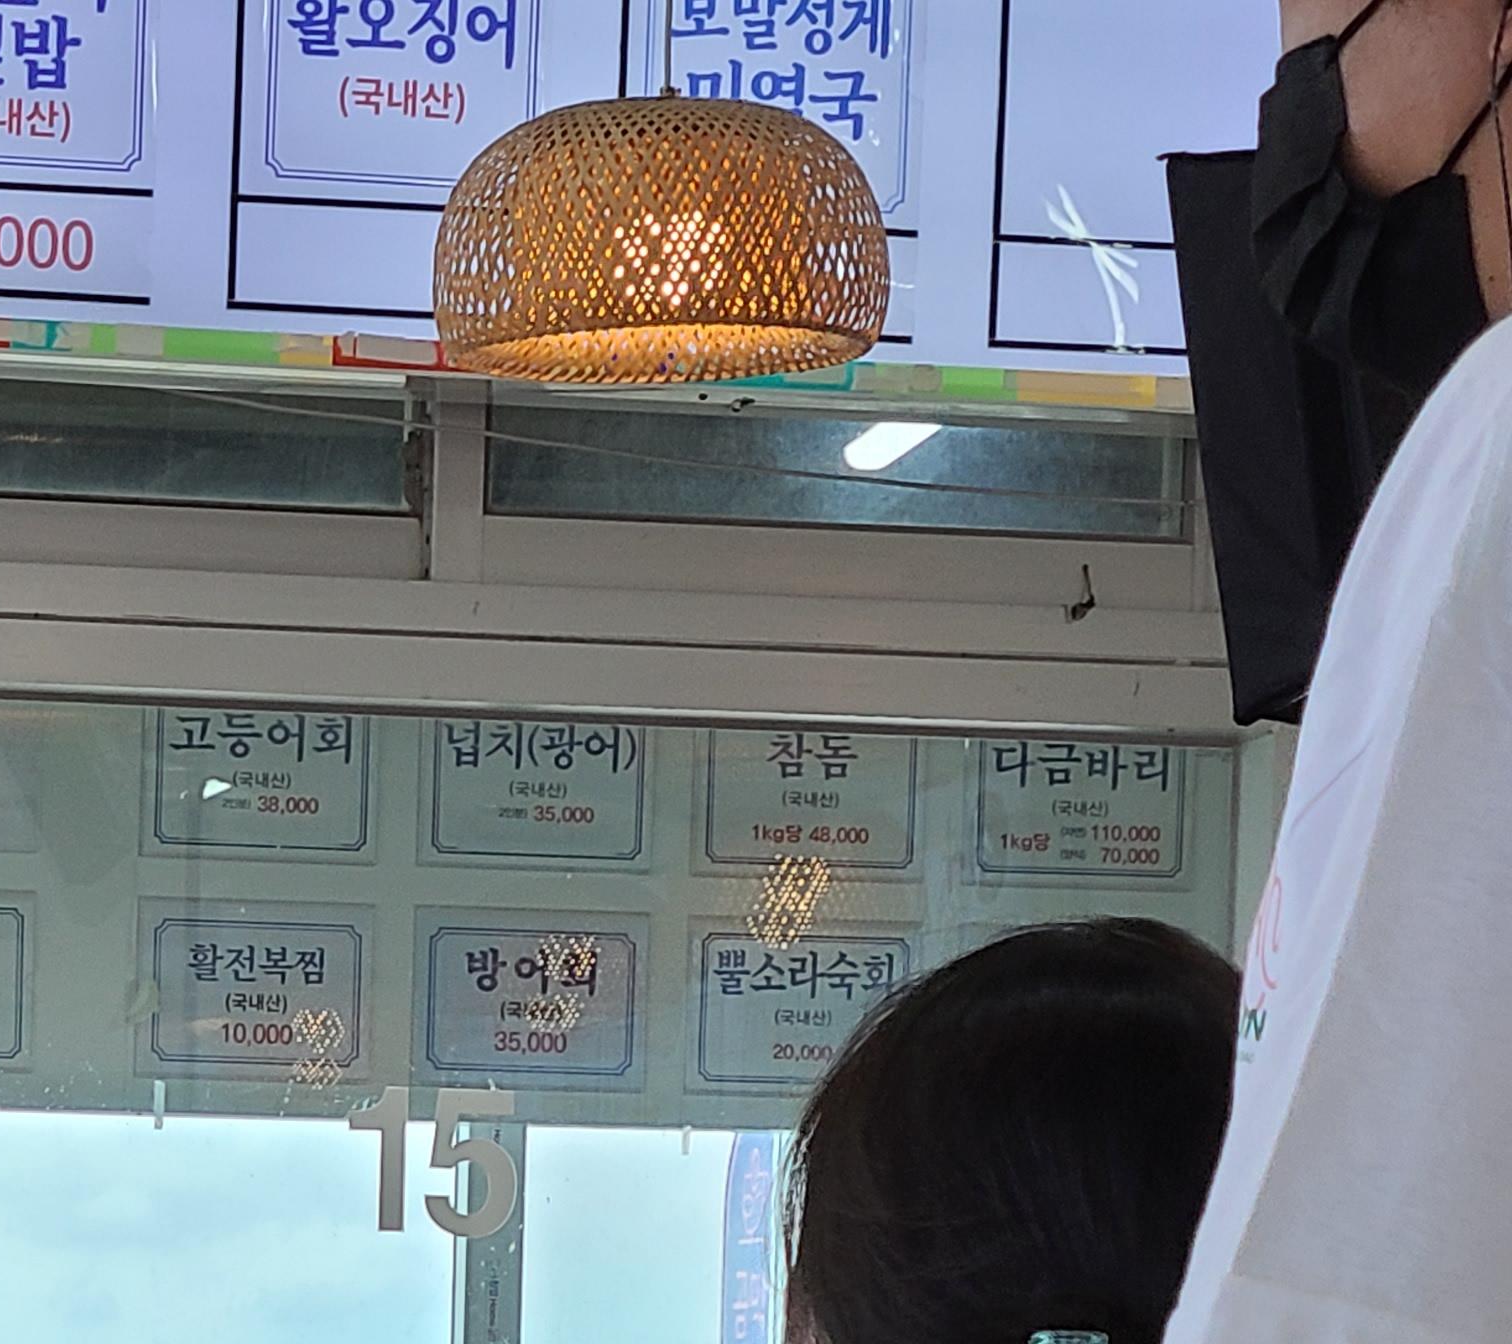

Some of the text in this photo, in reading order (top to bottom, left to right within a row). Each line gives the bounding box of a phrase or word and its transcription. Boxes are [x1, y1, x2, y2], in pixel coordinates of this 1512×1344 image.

[339, 76, 466, 124] (국내산)
[687, 59, 878, 141] 미역국
[169, 713, 352, 764] 고등어회
[445, 721, 637, 773] 넙치(광어)
[766, 732, 859, 780] 참돔
[993, 741, 1169, 792] 다금바리
[232, 771, 292, 789] (국내산)
[509, 781, 568, 799] (국내산)
[782, 790, 840, 808] (국내산)
[1052, 800, 1109, 817] (국내산)
[752, 824, 803, 844] 1kg당
[1000, 833, 1051, 852] 1kg당
[188, 943, 326, 985] 활전복찜
[712, 949, 895, 1001] 뿔소라숙회
[225, 993, 288, 1015] (국내산)
[774, 1008, 832, 1027] (국내산)
[222, 1023, 294, 1047] 10,000
[493, 1031, 568, 1055] 35,000
[346, 1085, 518, 1238] 15
